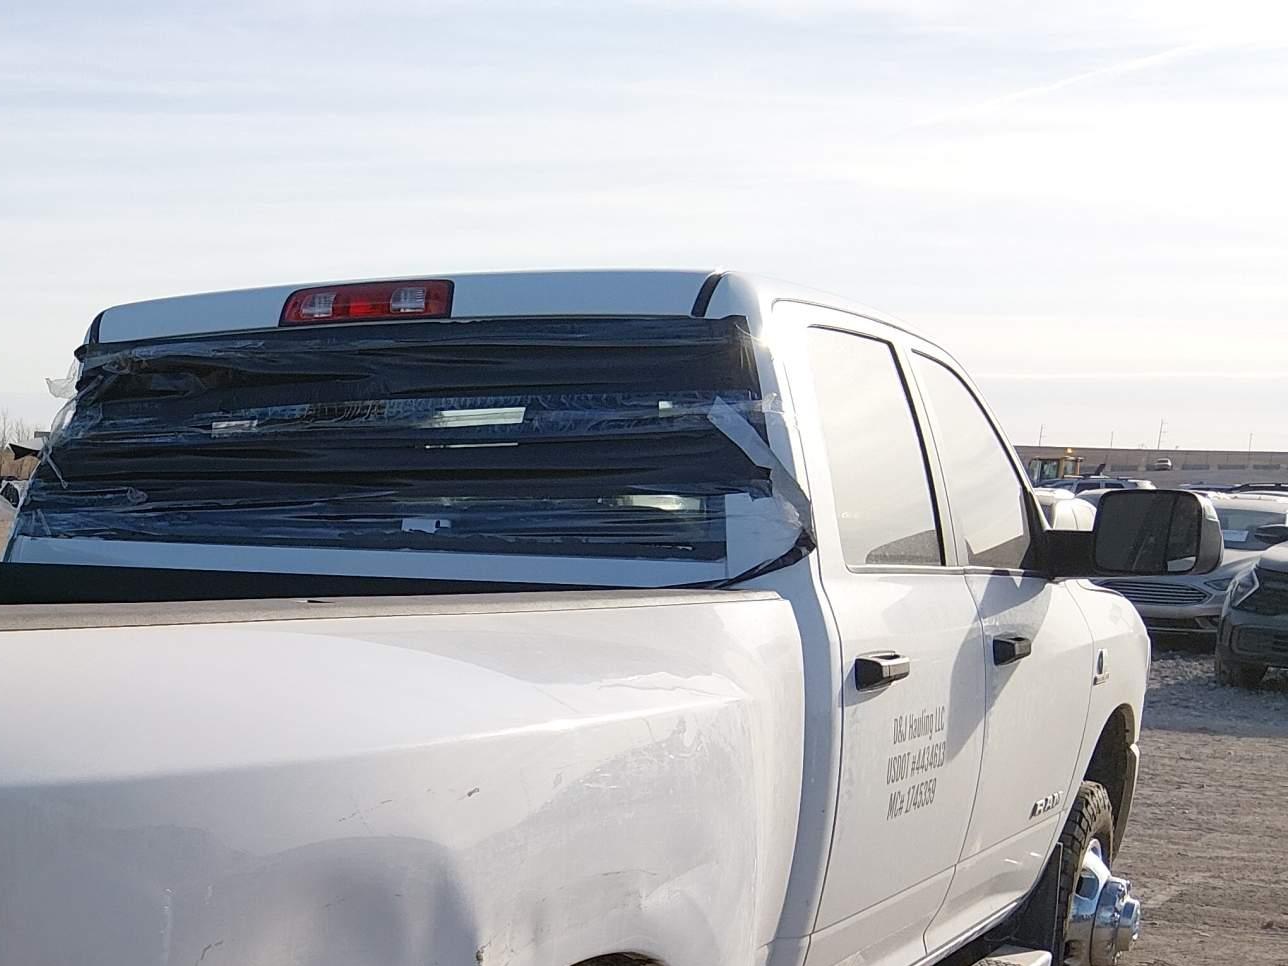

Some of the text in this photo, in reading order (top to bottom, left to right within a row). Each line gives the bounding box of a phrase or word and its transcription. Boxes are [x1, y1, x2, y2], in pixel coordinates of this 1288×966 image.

[893, 705, 945, 744] D&J Hauling LLC
[887, 752, 911, 785] USDOT
[887, 790, 905, 821] MC#
